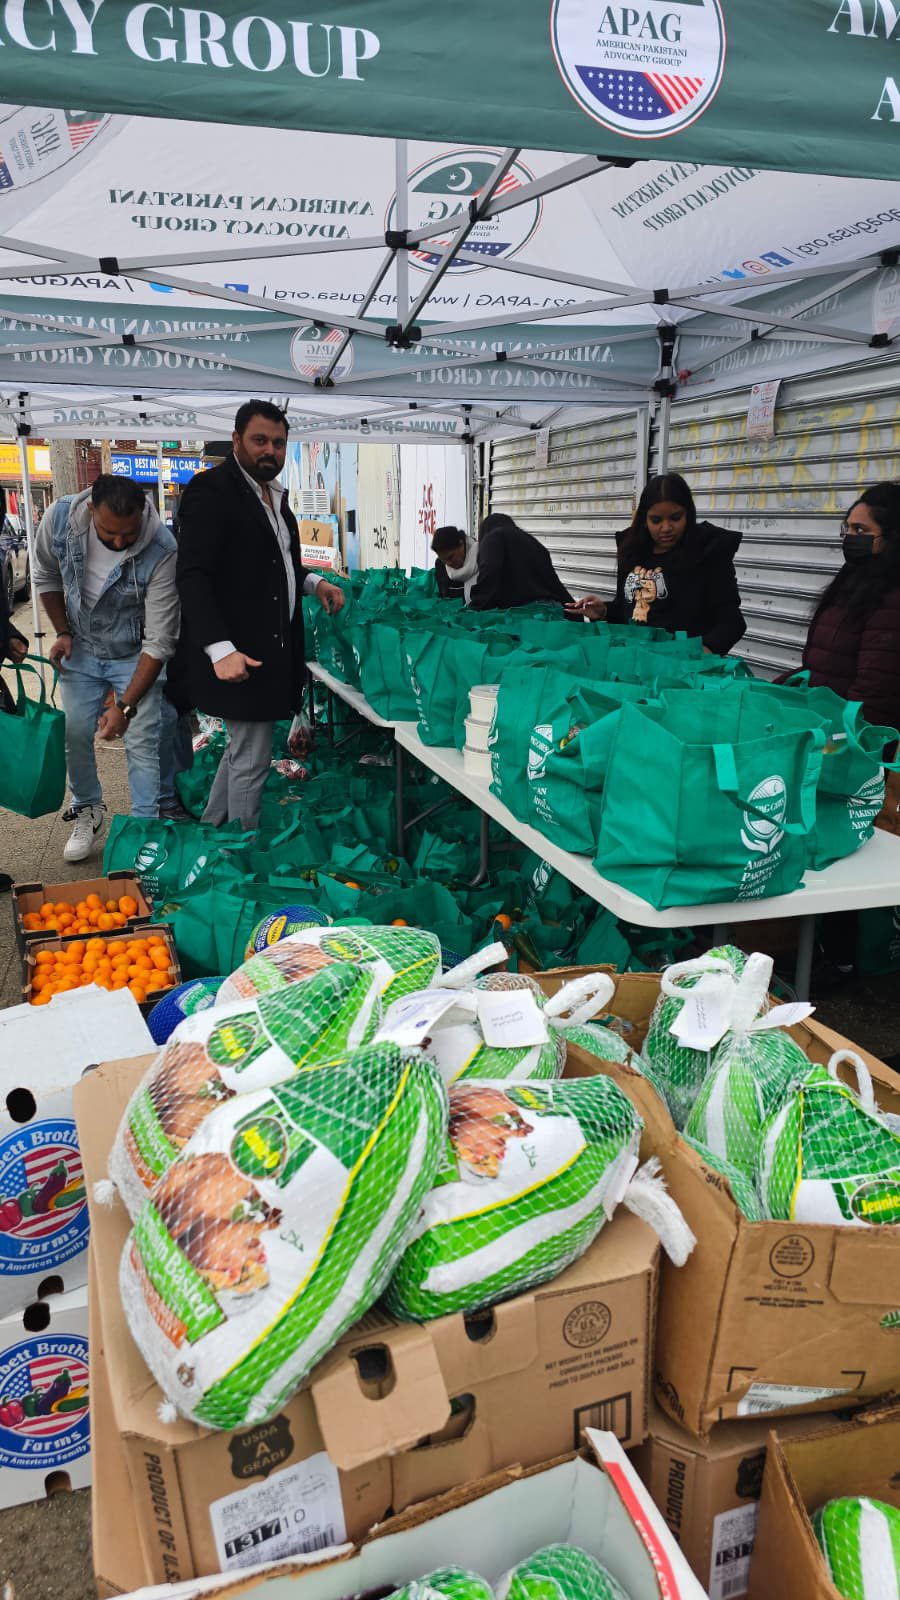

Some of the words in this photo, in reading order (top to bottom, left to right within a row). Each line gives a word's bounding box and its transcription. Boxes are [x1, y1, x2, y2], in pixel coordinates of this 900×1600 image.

[598, 5, 683, 43] APAG
[0, 0, 104, 56] CY
[125, 2, 381, 82] GROUP
[596, 39, 641, 51] AMERICAN
[643, 44, 688, 57] PAKISTANI
[604, 50, 651, 63] ADVOCACY
[652, 56, 682, 67] GROUP
[134, 458, 148, 469] BEST
[744, 850, 782, 871] AMERICAN
[19, 1225, 80, 1256] Farms
[6, 1257, 53, 1272] American
[55, 1239, 86, 1262] Family
[0, 1349, 33, 1381] bett
[22, 1430, 82, 1452] Farms
[242, 1424, 279, 1448] USDA
[12, 1455, 55, 1466] American
[57, 1443, 87, 1462] Family
[242, 1448, 287, 1475] GRADE
[256, 1441, 271, 1458] A
[143, 1451, 172, 1528] PRODUCT
[667, 1457, 687, 1528] PRODUCT
[157, 1528, 176, 1551] OF
